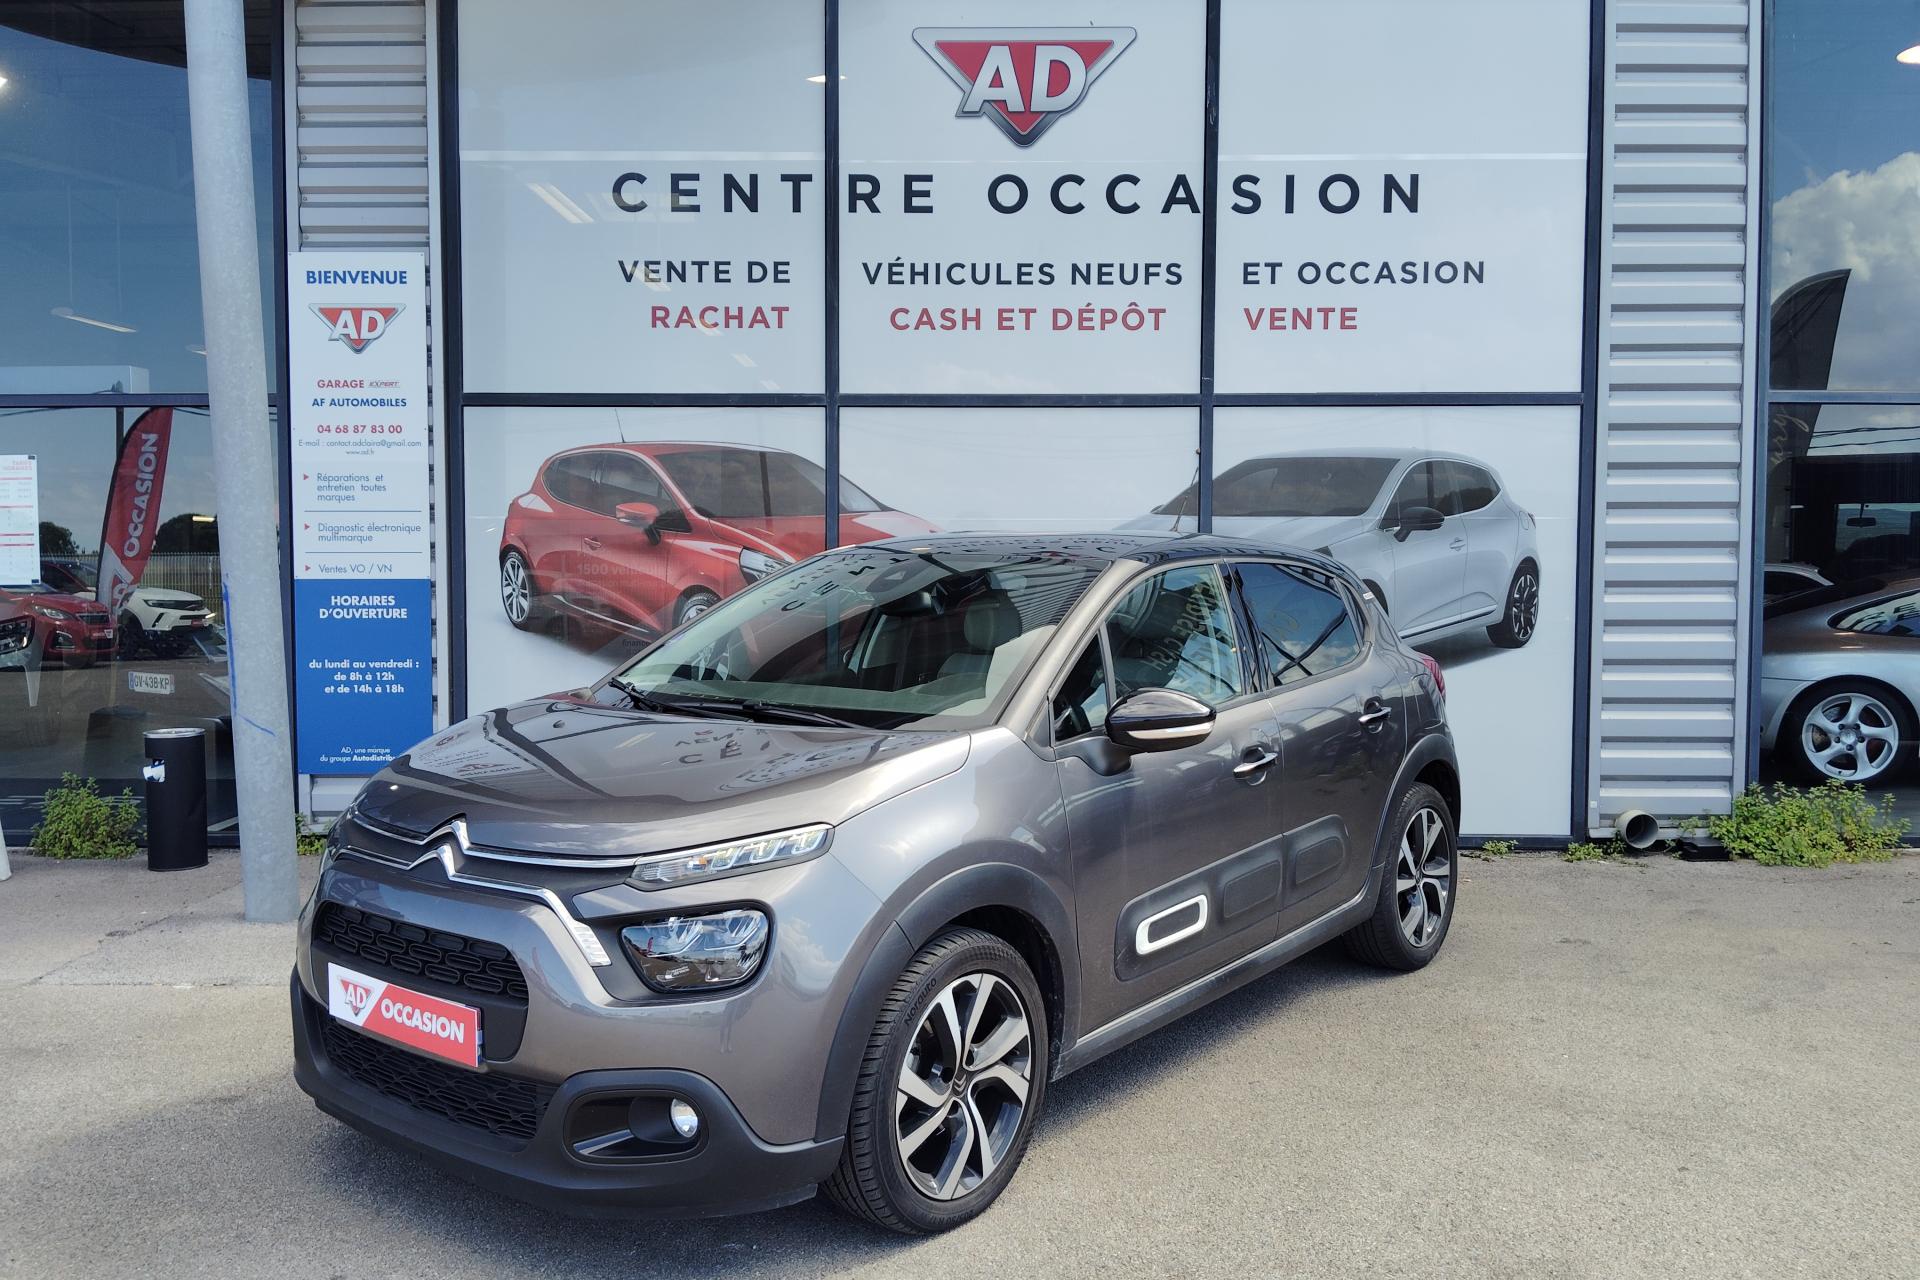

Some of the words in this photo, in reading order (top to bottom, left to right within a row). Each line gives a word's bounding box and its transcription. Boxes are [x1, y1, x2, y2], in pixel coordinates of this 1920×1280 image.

[959, 44, 1087, 113] AD
[612, 172, 934, 214] CENTRE
[987, 173, 1420, 215] OCCASION
[618, 260, 732, 283] VENTE
[747, 261, 791, 283] DE
[862, 257, 1055, 285] VÉHICULES
[1071, 262, 1183, 285] NEUFS
[1242, 263, 1283, 285] ET
[1297, 261, 1485, 285] OCCASION
[306, 270, 408, 285] BIENVENUE
[651, 306, 790, 329] RACHAT
[890, 308, 982, 331] CASH
[998, 308, 1037, 331] ET
[1052, 302, 1167, 331] DÉPÔT
[1243, 307, 1358, 331] VENTE
[330, 309, 386, 340] AD
[317, 379, 364, 389] GARAGE
[311, 398, 326, 407] AF
[329, 398, 407, 407] AUTOMOBILES
[317, 425, 331, 434] 04
[335, 425, 348, 434] 68
[353, 425, 366, 434] 87
[371, 425, 384, 434] 83
[388, 425, 402, 434] 00
[298, 439, 320, 447] E-mail
[317, 472, 370, 485] Réparations
[375, 474, 384, 483] et
[317, 483, 355, 492] entretien
[361, 484, 387, 492] toutes
[124, 433, 159, 558] OCCASION
[317, 494, 356, 503] marques
[318, 523, 366, 535] Diagnostic
[367, 523, 422, 535] électronique
[318, 534, 373, 543] multimarque
[318, 565, 347, 574] Ventes
[350, 564, 366, 573] VO
[377, 564, 393, 573] VN
[331, 595, 396, 606] HORAIRES
[319, 607, 408, 619] D'OUVERTURE
[309, 660, 322, 669] du
[324, 660, 350, 669] lundi
[353, 661, 366, 669] au
[368, 660, 413, 669] vendredi
[334, 672, 347, 681] de
[350, 672, 363, 681] 8h
[365, 672, 372, 681] à
[376, 672, 394, 681] 12h
[324, 684, 334, 693] et
[337, 684, 350, 693] de
[353, 684, 372, 693] 14h
[375, 684, 382, 693] à
[385, 684, 404, 693] 18h
[367, 748, 391, 756] marque
[345, 984, 368, 1009] AD
[381, 998, 465, 1043] OCCASION
